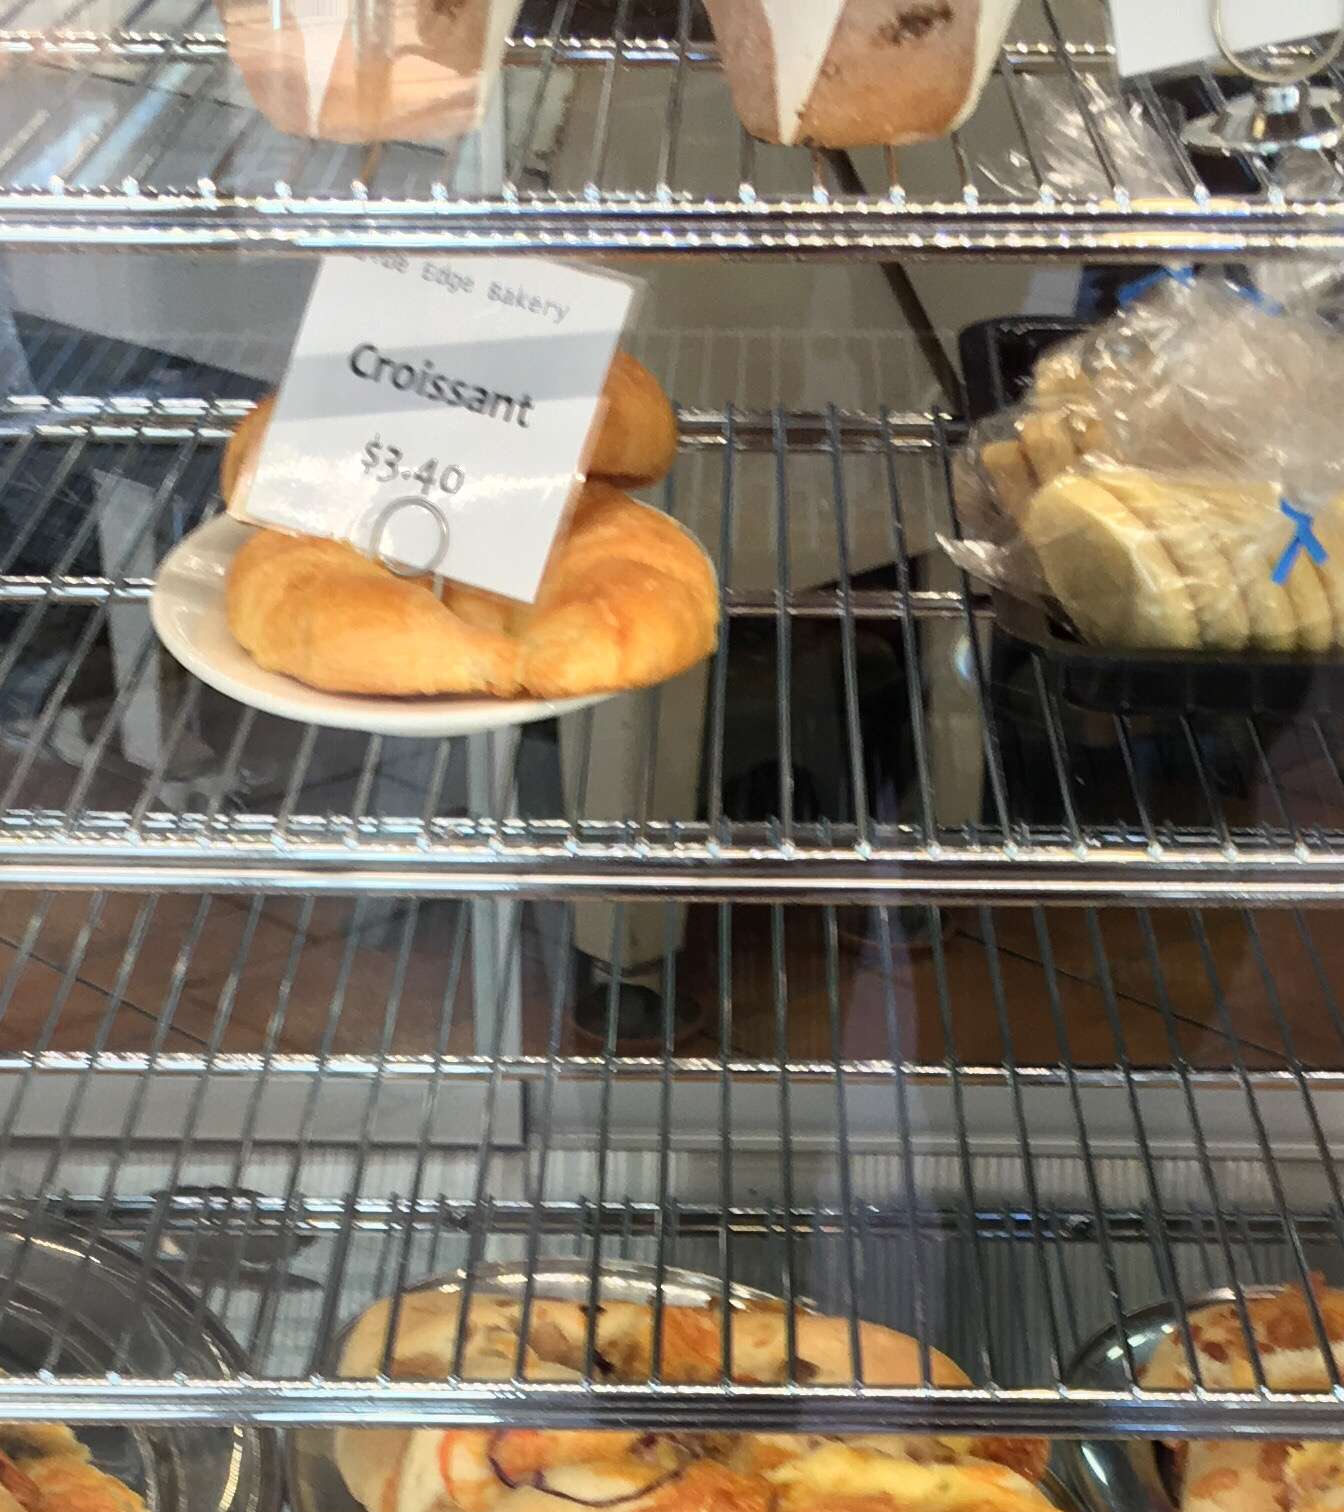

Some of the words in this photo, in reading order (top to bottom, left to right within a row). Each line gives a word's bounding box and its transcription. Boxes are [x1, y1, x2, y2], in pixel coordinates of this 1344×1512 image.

[421, 258, 476, 294] Edge
[487, 281, 571, 323] Bakery
[348, 341, 536, 429] Croissant
[360, 432, 466, 496] $3.40
